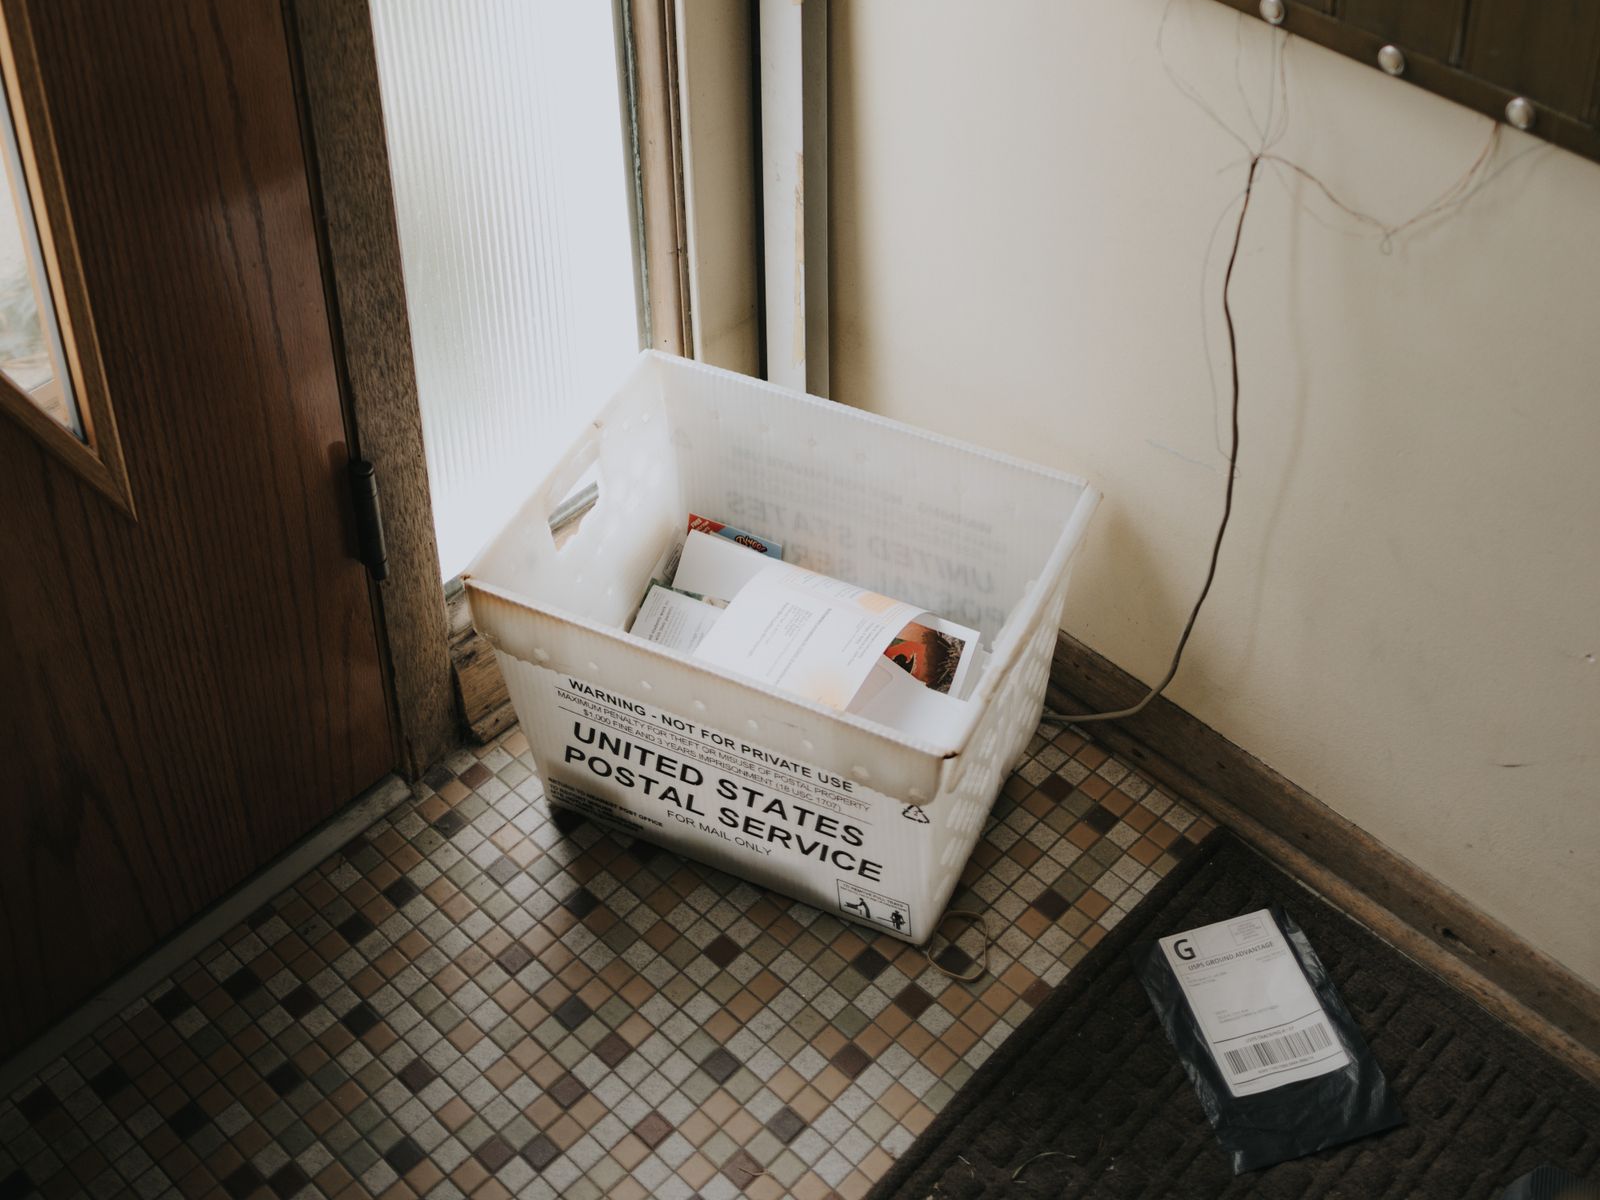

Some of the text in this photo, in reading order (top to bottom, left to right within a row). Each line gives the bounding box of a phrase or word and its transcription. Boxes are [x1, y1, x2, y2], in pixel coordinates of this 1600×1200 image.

[557, 690, 870, 812] MAXIMUM PENALTY FOR THEFT OR MISUSE OF POSTAL PROPERTY
[569, 678, 646, 716] WARNING
[661, 714, 696, 734] NOT
[701, 729, 736, 750] FOR
[741, 744, 812, 778] PRIVATE
[817, 772, 853, 793] USE
[573, 721, 703, 787] UNITED
[716, 778, 864, 847] STATES
[583, 708, 611, 725] $1,000
[613, 717, 634, 732] FINE
[635, 729, 656, 742] AND
[665, 740, 697, 758] YEARS
[699, 753, 773, 790] IMPRISONMENT
[790, 785, 814, 801] USC
[564, 745, 705, 816] POSTAL
[718, 807, 883, 882] SERVICE
[667, 809, 696, 828] FOR
[700, 822, 732, 842] MAIL
[734, 836, 772, 856] ONLY
[1173, 938, 1197, 961] G
[1187, 961, 1206, 972] USPS
[1205, 953, 1235, 967] GROUND
[1234, 940, 1274, 959] ADVANTAGE
